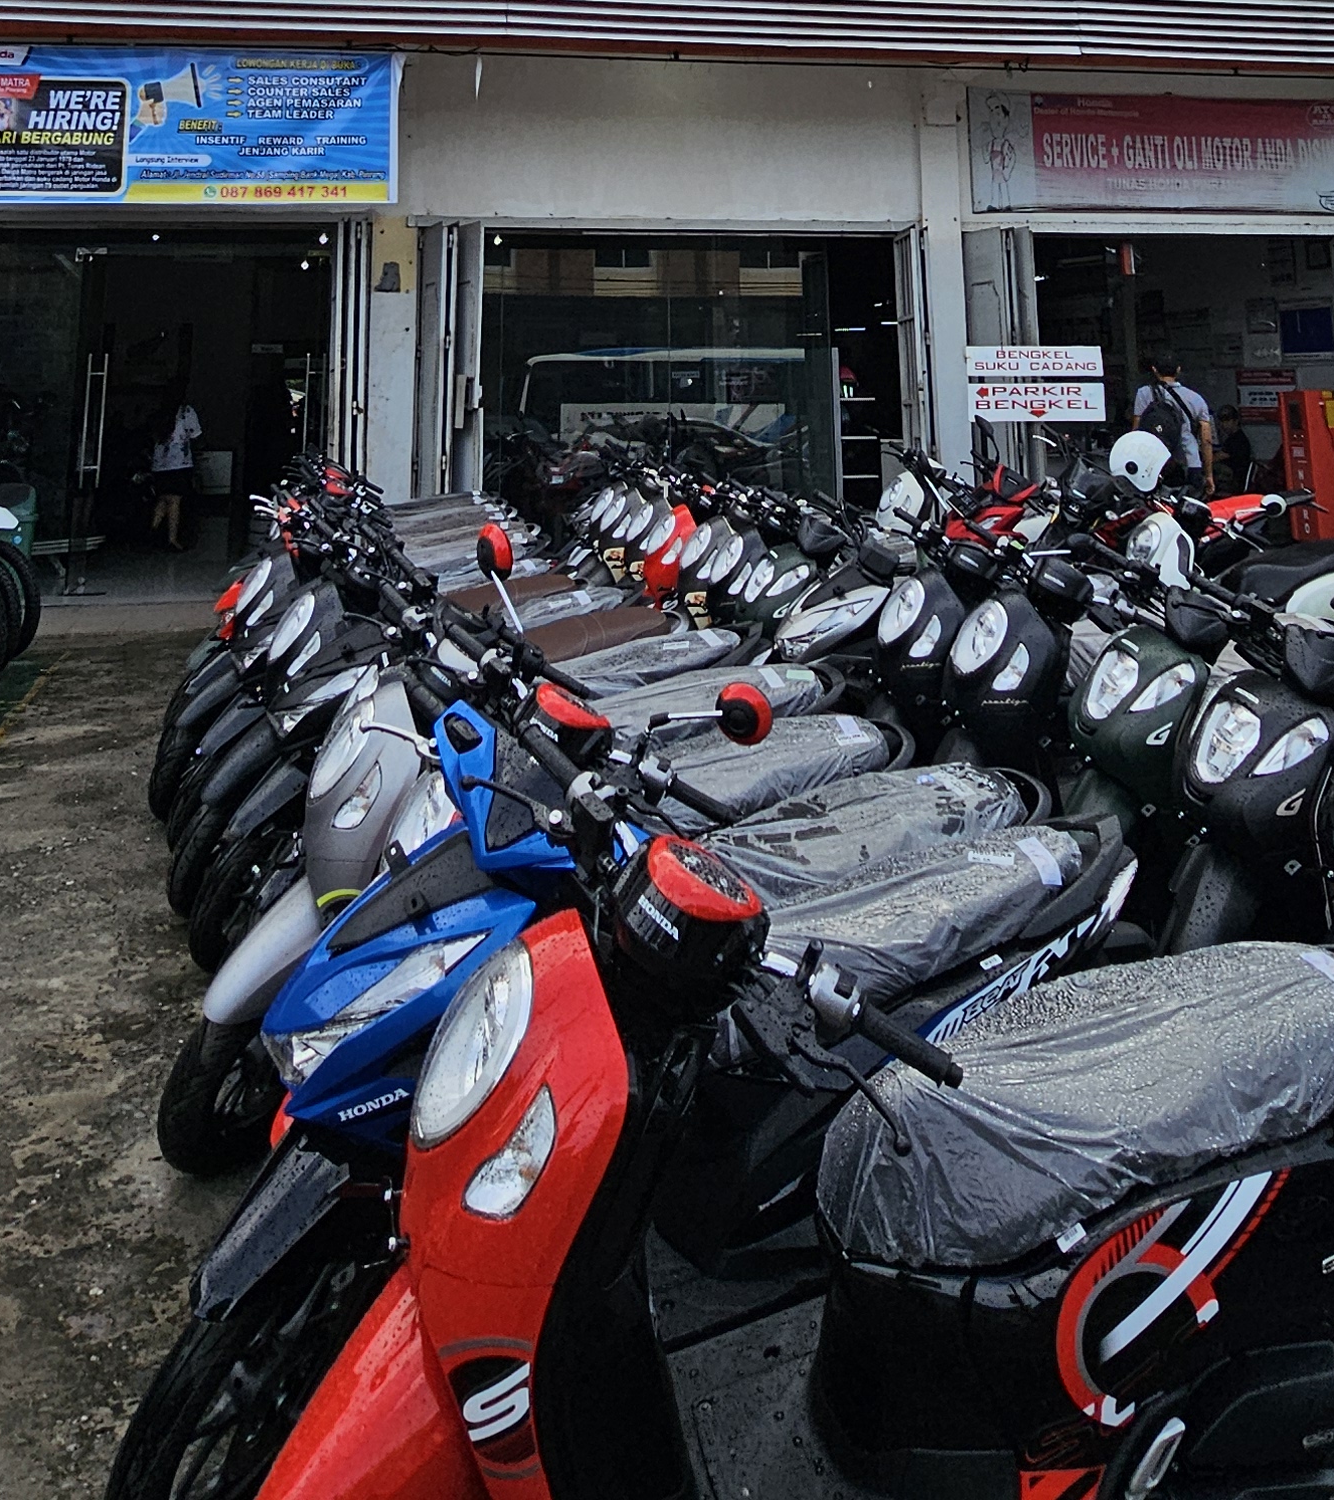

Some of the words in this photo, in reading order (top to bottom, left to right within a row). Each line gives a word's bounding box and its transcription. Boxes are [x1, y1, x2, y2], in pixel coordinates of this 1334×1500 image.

[1, 78, 31, 88] MATRA
[247, 75, 288, 86] SALES
[291, 76, 367, 87] CONSUTANT
[247, 87, 308, 98] COUNTER
[311, 88, 351, 98] SALES
[49, 89, 122, 110] WE'RE
[247, 98, 282, 108] AGEN
[285, 99, 362, 109] PEMASARAN
[247, 109, 282, 119] TEAM
[285, 109, 334, 120] LEADER
[27, 110, 120, 131] HIRING!
[178, 120, 217, 132] BENEFIT
[20, 131, 115, 146] BERGABUNG
[196, 136, 247, 146] INSENTIF
[258, 136, 304, 146] REWARD
[316, 136, 367, 146] TRAINING
[238, 146, 288, 157] JENJANG
[291, 146, 325, 156] KARIR
[1043, 132, 1108, 169] SERVICE
[1111, 138, 1119, 165] +
[1123, 134, 1171, 171] GANTI
[1173, 135, 1198, 171] OLI
[1200, 136, 1254, 171] MOTOR
[1256, 137, 1296, 172] ANDA
[220, 186, 247, 198] 087
[254, 186, 282, 198] 869
[287, 186, 314, 198] 417
[321, 186, 347, 198] 341
[996, 350, 1074, 360] BENGKEL
[974, 362, 1019, 371] SUKU
[1029, 362, 1097, 371] CADANG
[992, 386, 1082, 396] PARKIR
[975, 399, 1098, 410] BENGKEL
[1297, 469, 1311, 535] NIRO
[637, 893, 679, 942] HONDA
[337, 1087, 410, 1122] HONDA
